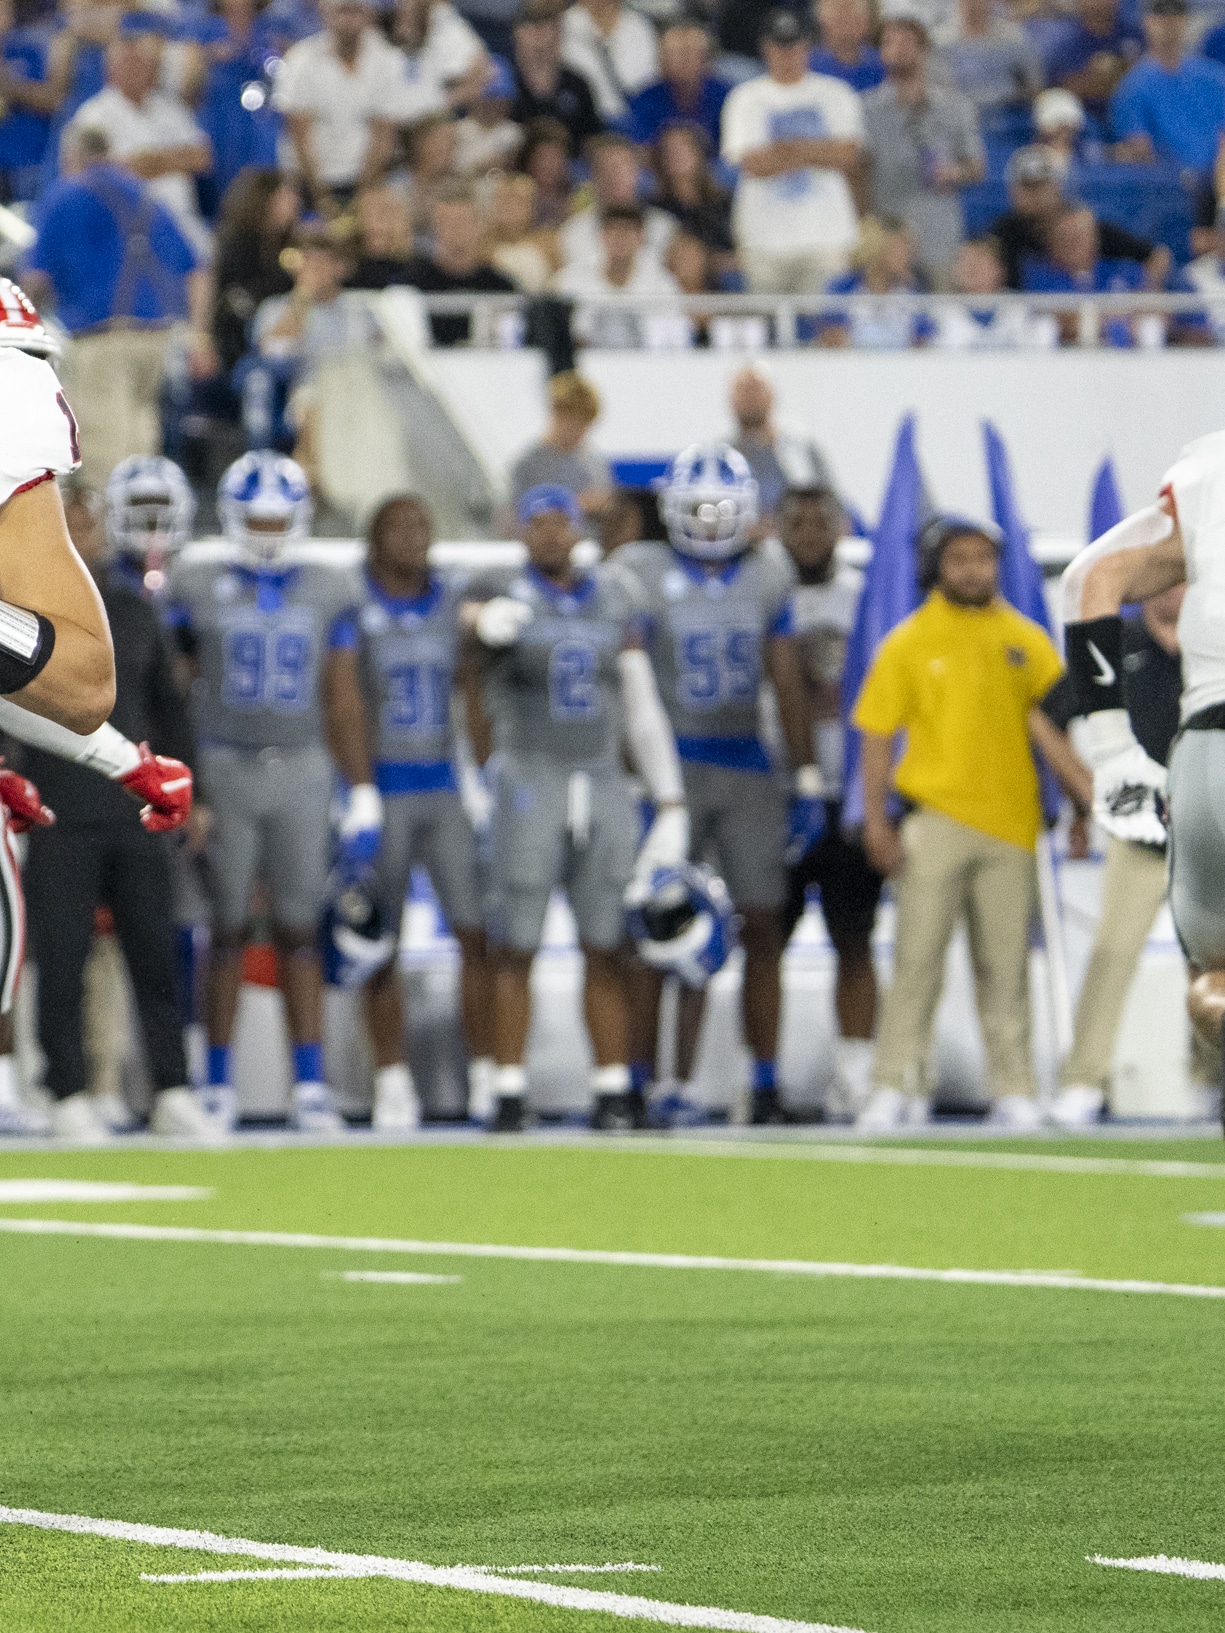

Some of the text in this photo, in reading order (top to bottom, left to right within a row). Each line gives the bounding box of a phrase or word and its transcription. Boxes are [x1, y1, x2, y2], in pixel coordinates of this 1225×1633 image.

[225, 628, 313, 706] 99
[385, 662, 450, 727] 31
[553, 643, 597, 716] 2
[680, 628, 759, 706] 55
